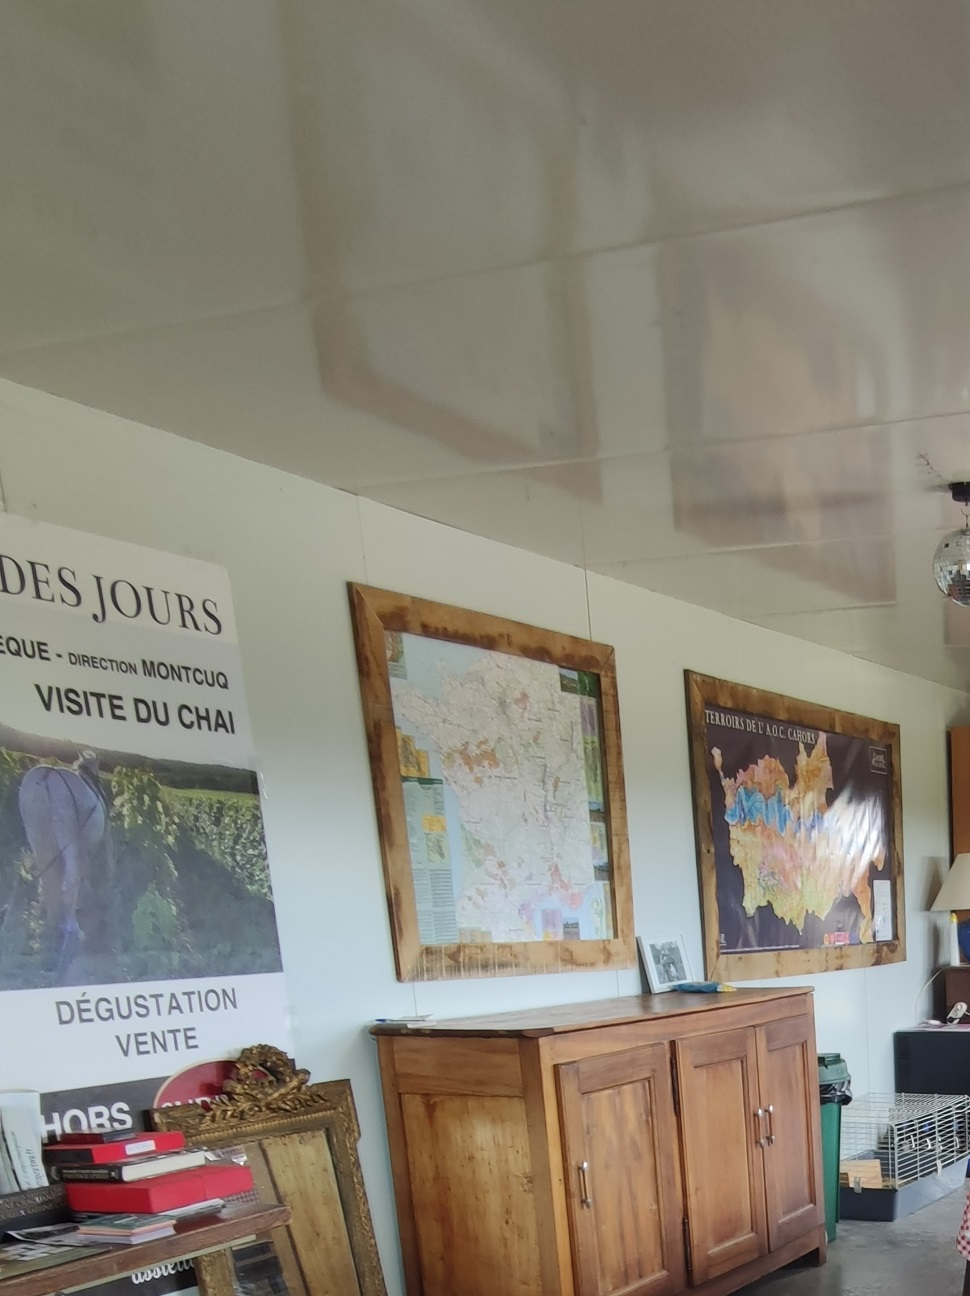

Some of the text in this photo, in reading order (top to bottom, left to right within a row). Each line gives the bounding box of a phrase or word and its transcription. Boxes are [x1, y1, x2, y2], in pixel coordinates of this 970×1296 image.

[0, 554, 222, 635] DES JOURS
[68, 652, 138, 675] DIRECTION
[141, 659, 229, 690] MONTCUQ
[34, 683, 236, 735] VISITE DU CHAI
[705, 709, 745, 730] TERROIRS
[746, 719, 757, 732] DE
[788, 728, 816, 744] CAHORS
[55, 987, 239, 1026] DÉGUSTATION
[115, 1027, 199, 1059] VENTE
